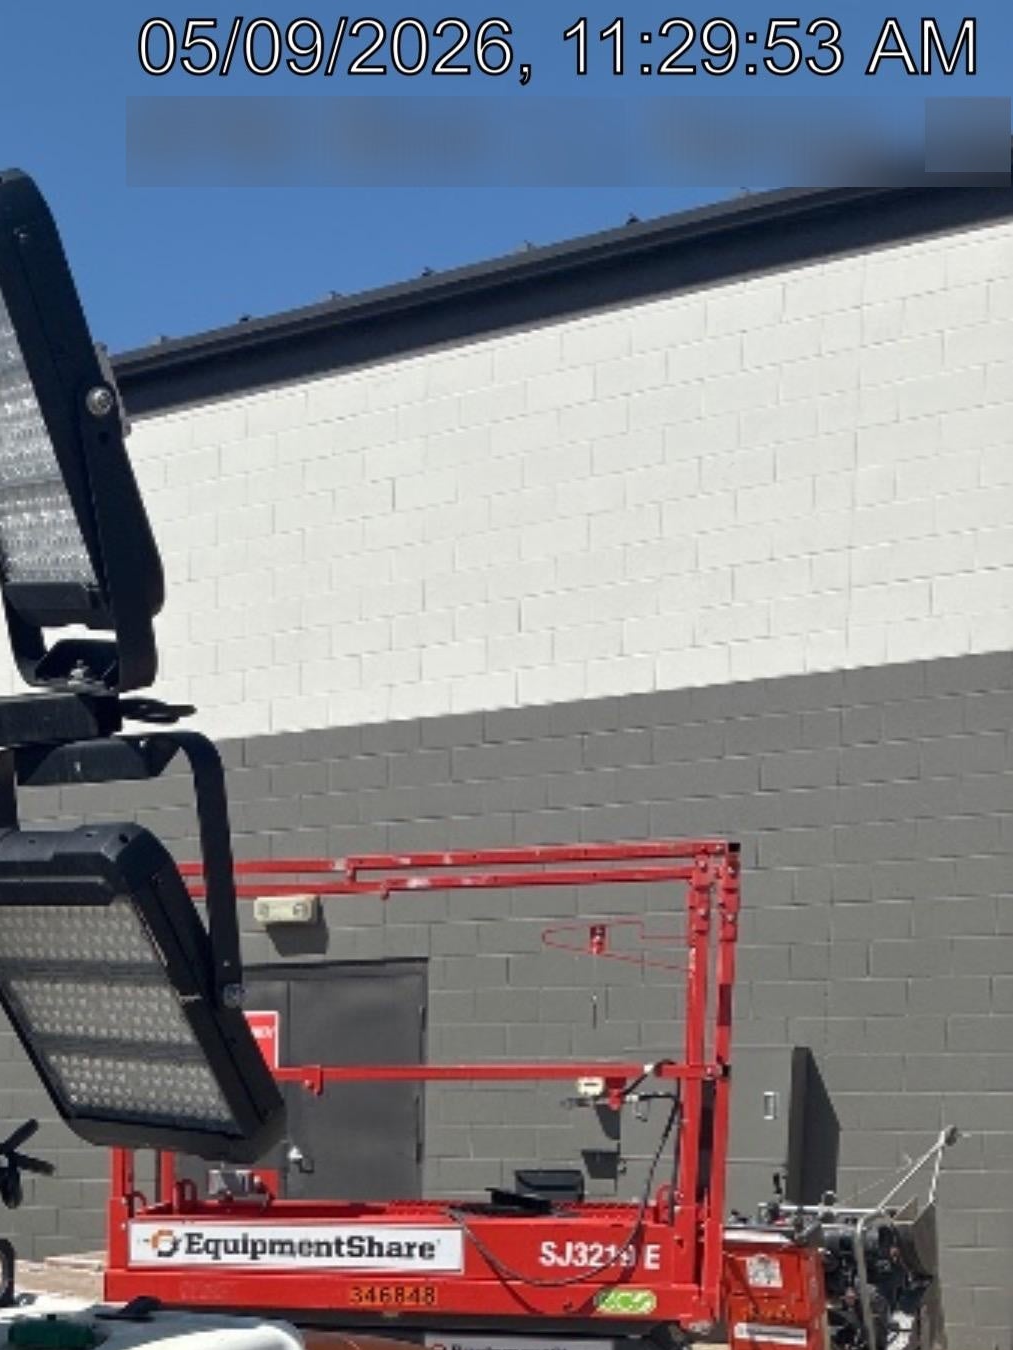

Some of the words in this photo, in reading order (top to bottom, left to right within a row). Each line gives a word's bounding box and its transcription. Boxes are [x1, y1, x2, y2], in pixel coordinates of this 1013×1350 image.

[184, 1231, 437, 1261] EquipmentShare
[644, 1244, 661, 1270] E
[350, 1286, 436, 1305] 346848
